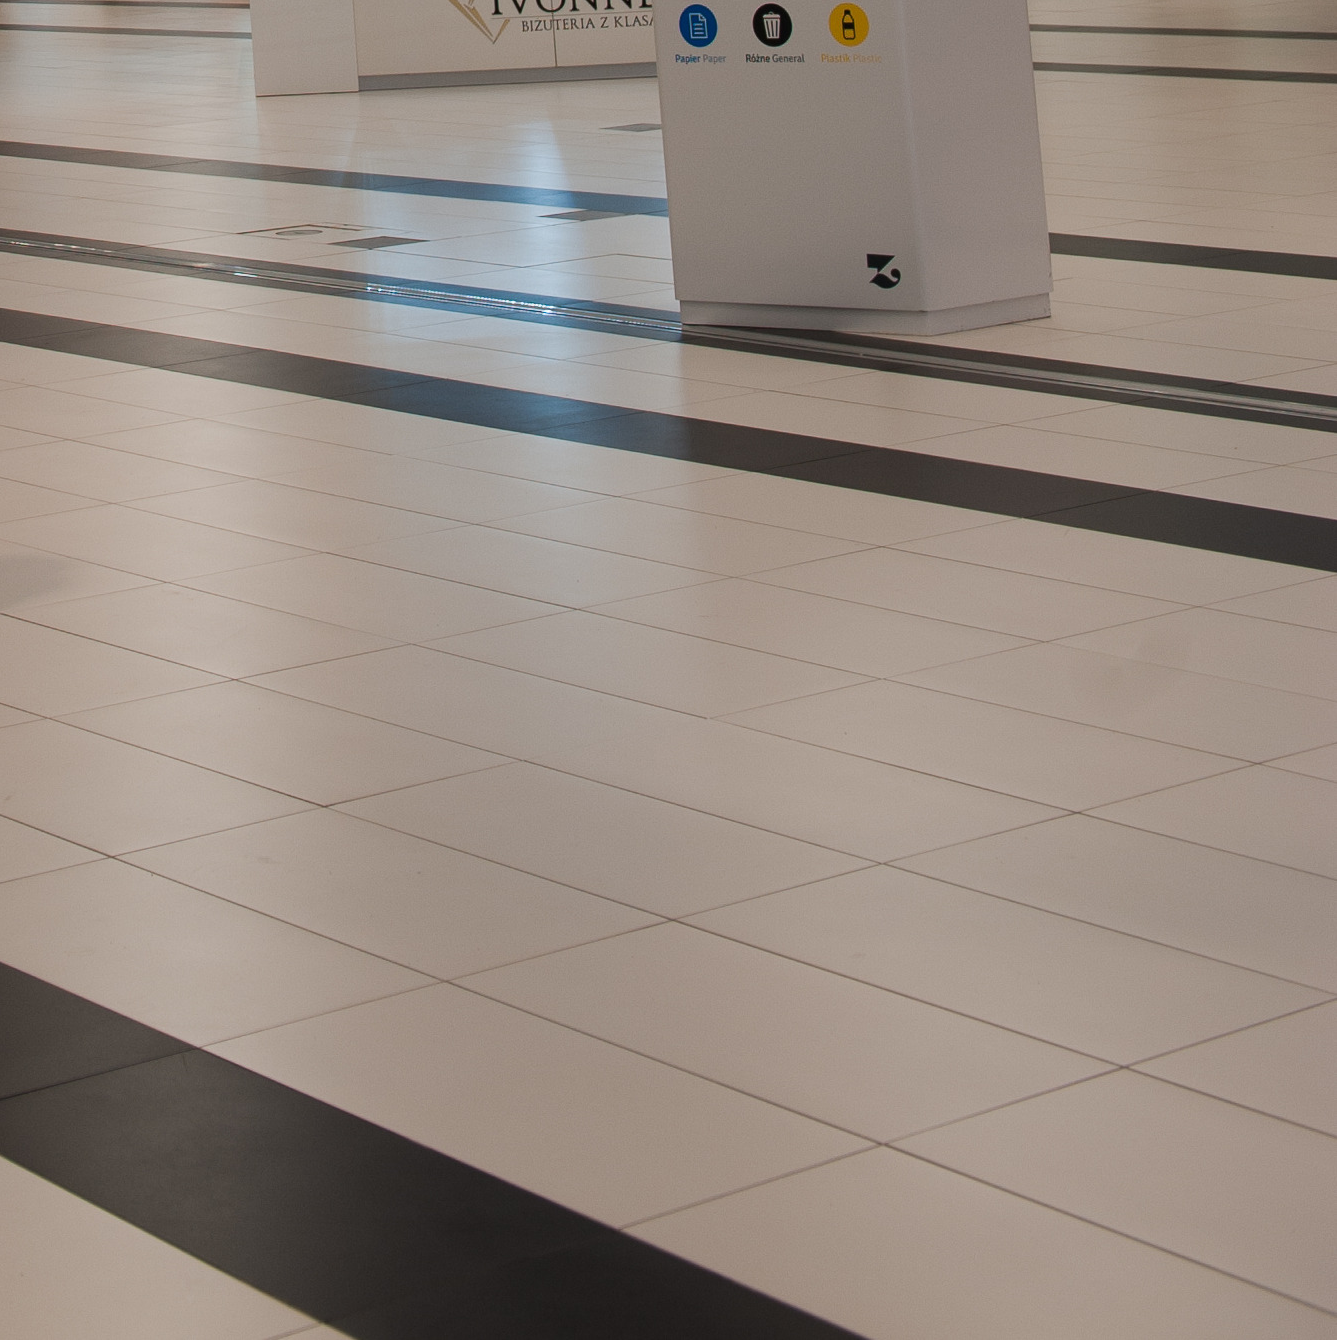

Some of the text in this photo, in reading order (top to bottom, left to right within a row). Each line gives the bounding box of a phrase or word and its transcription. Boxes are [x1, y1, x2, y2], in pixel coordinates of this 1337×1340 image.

[600, 17, 609, 29] Z
[674, 54, 727, 65] Papier Paper
[772, 54, 805, 63] General
